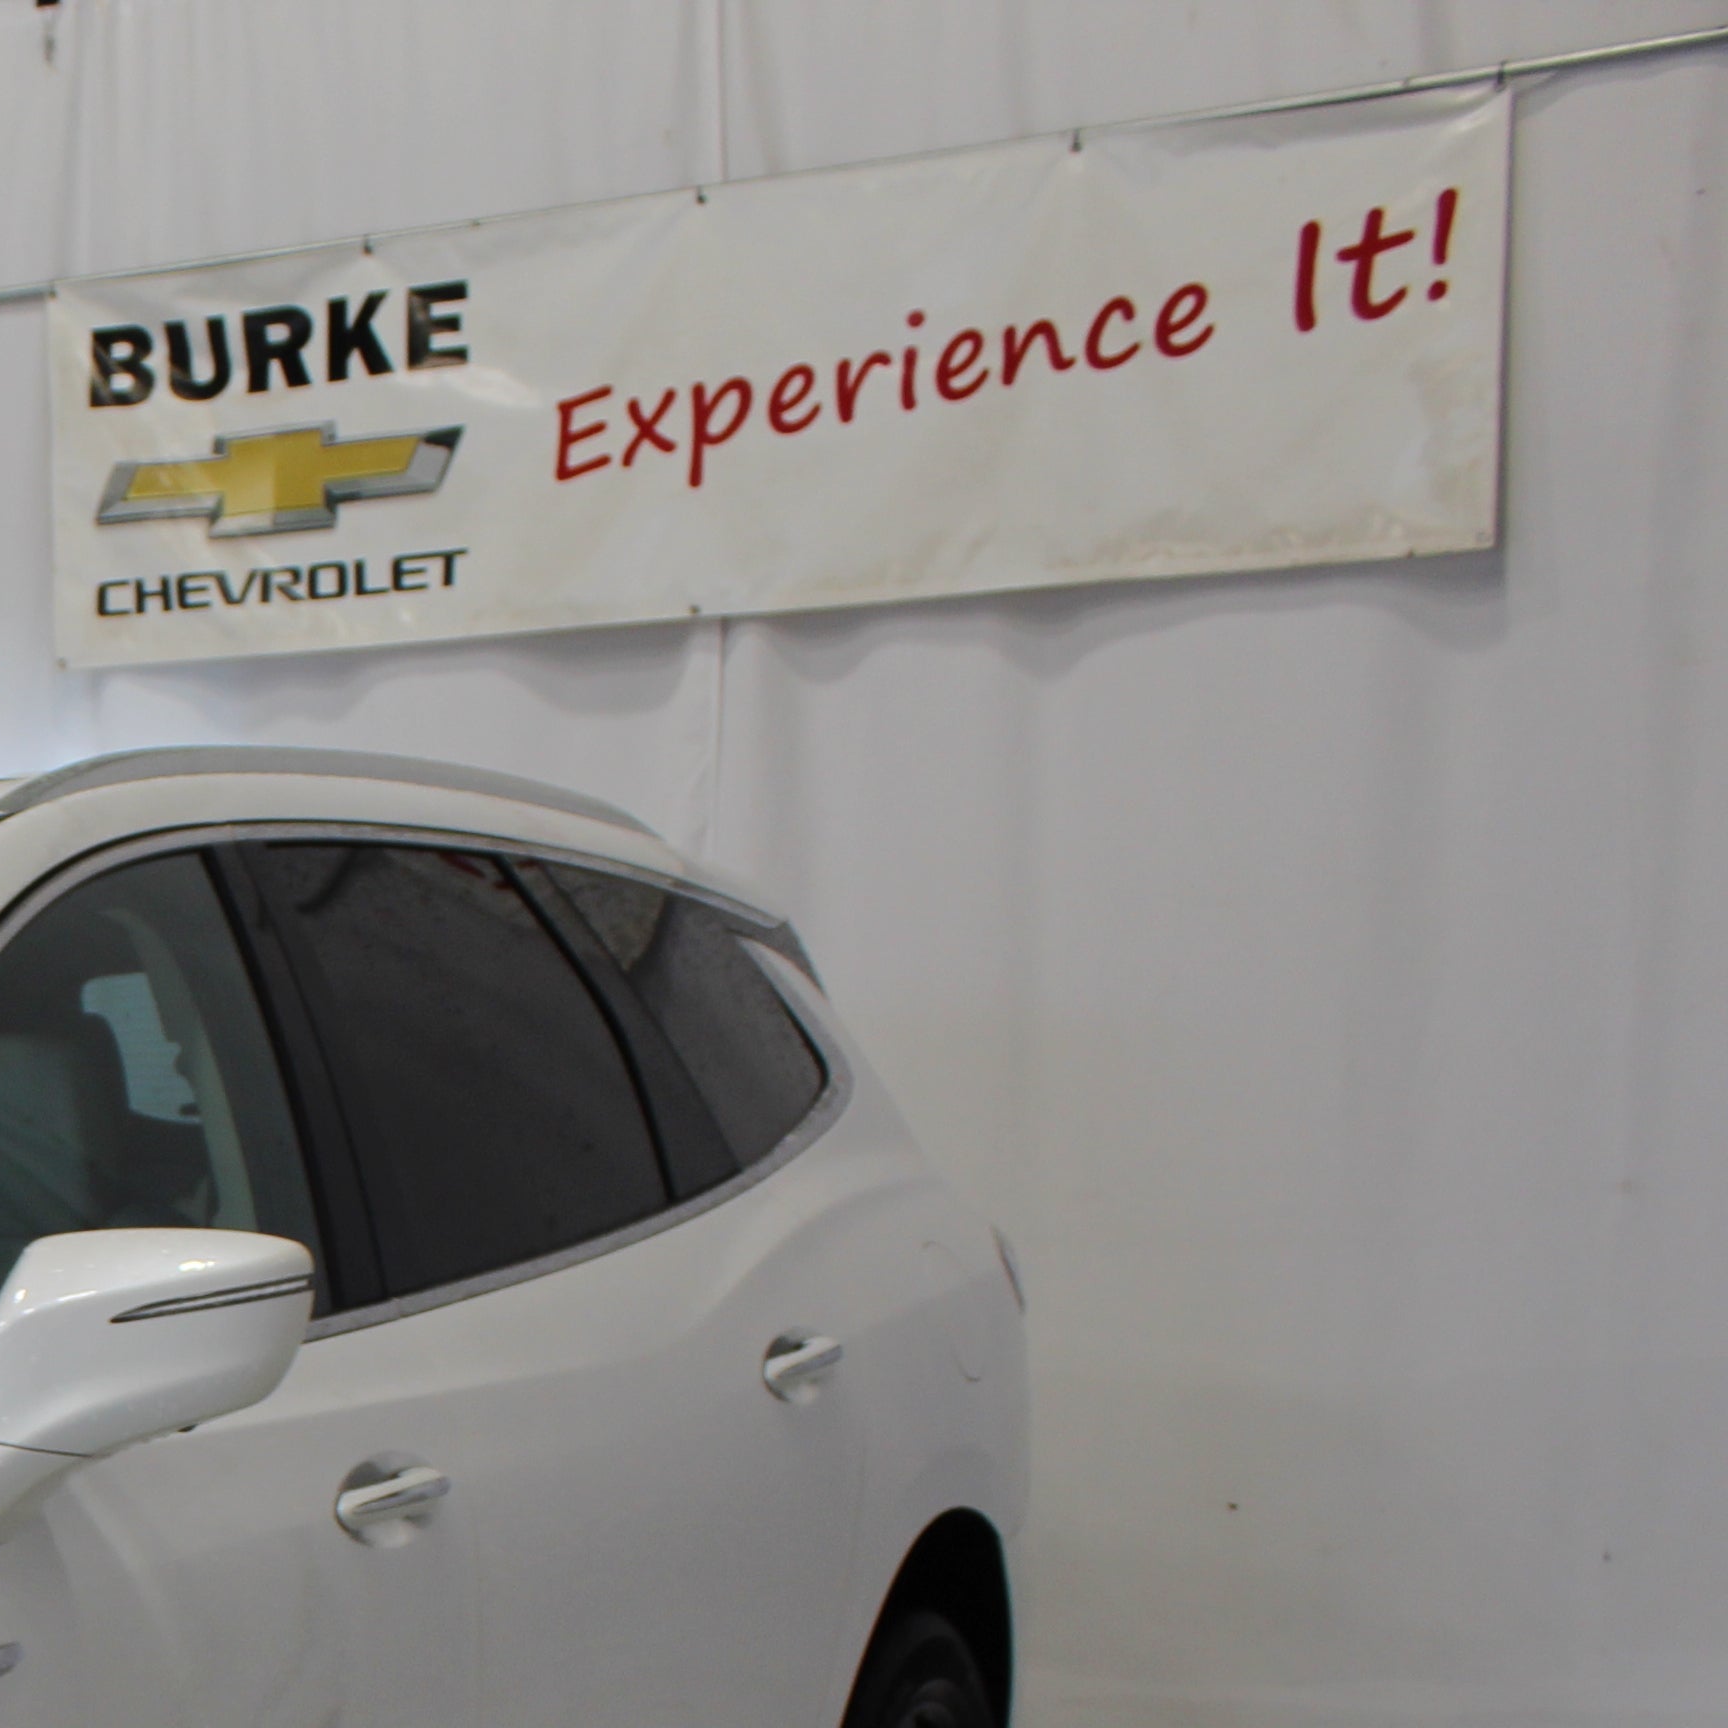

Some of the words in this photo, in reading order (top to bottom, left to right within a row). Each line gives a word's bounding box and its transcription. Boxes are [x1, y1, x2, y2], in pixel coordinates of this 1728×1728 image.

[89, 281, 468, 408] BURKE
[553, 283, 1215, 490] Experience
[1291, 187, 1460, 334] It!
[97, 547, 469, 616] CHEVROLET
